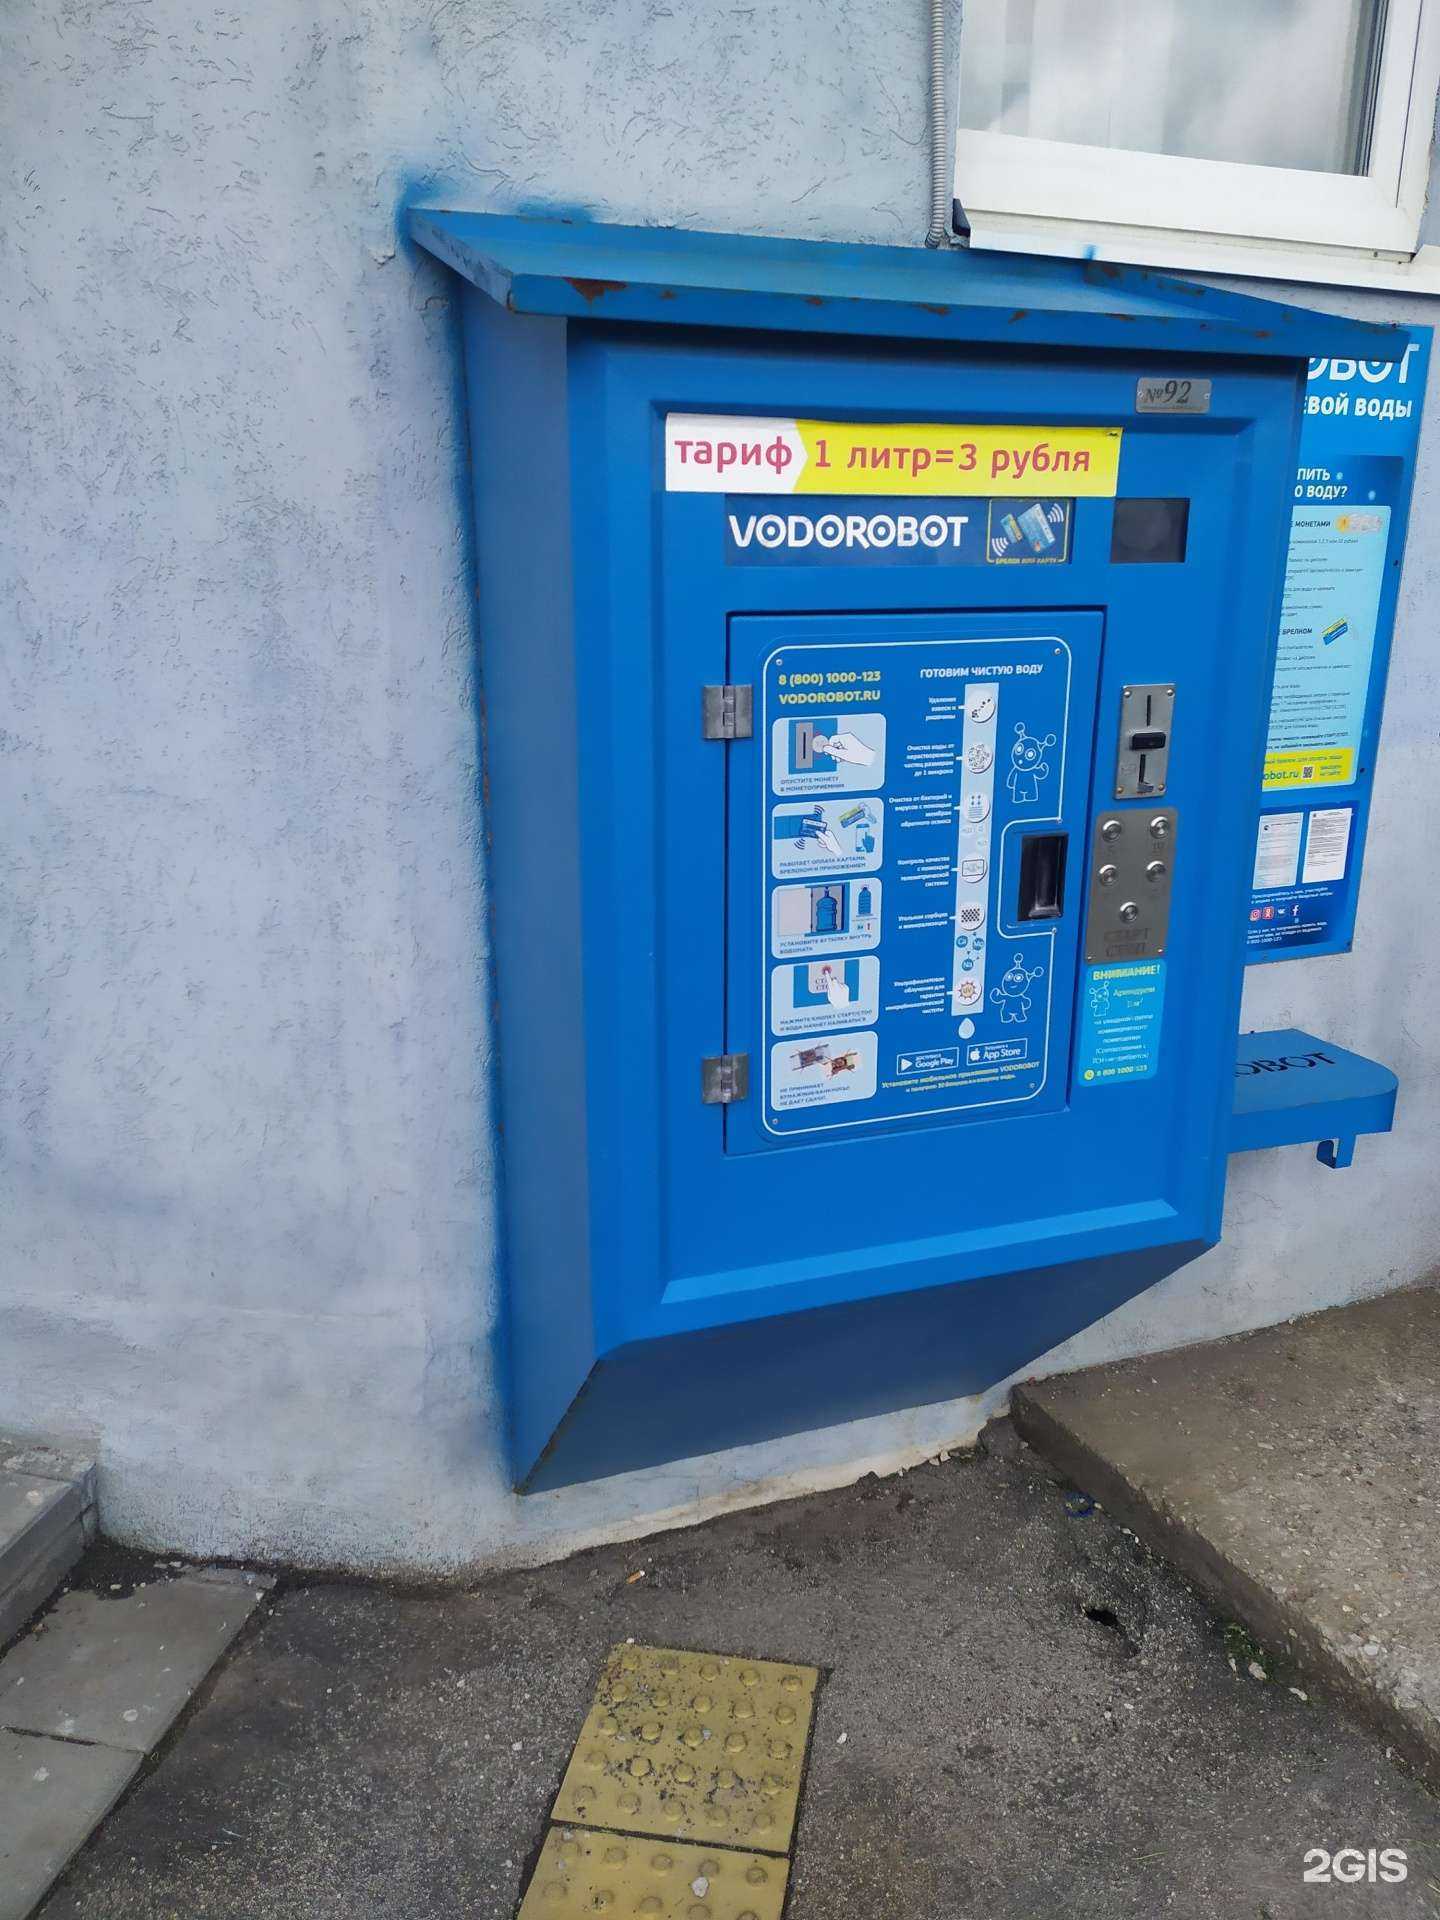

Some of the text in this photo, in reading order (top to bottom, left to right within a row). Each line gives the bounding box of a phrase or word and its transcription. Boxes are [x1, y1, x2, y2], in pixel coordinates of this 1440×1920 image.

[1304, 392, 1412, 420] ВОЙ ВОДЫ
[675, 437, 793, 474] тариф
[814, 440, 830, 468] 1
[991, 443, 1090, 478] рубля
[1297, 468, 1330, 480] ПИТЬ
[1306, 486, 1347, 500] ВОДУ?
[728, 514, 968, 549] VODOROBOT
[778, 670, 881, 688] 8 (800) 1000-123
[920, 663, 1043, 679] ГОТОВИМ ЧИСТУЮ ВОДУ
[779, 689, 881, 704] VODOROBOT.RU
[1093, 964, 1160, 981] ВНИМАНИЕ!
[983, 1048, 1021, 1060] App Store
[915, 1057, 954, 1068] Google Play
